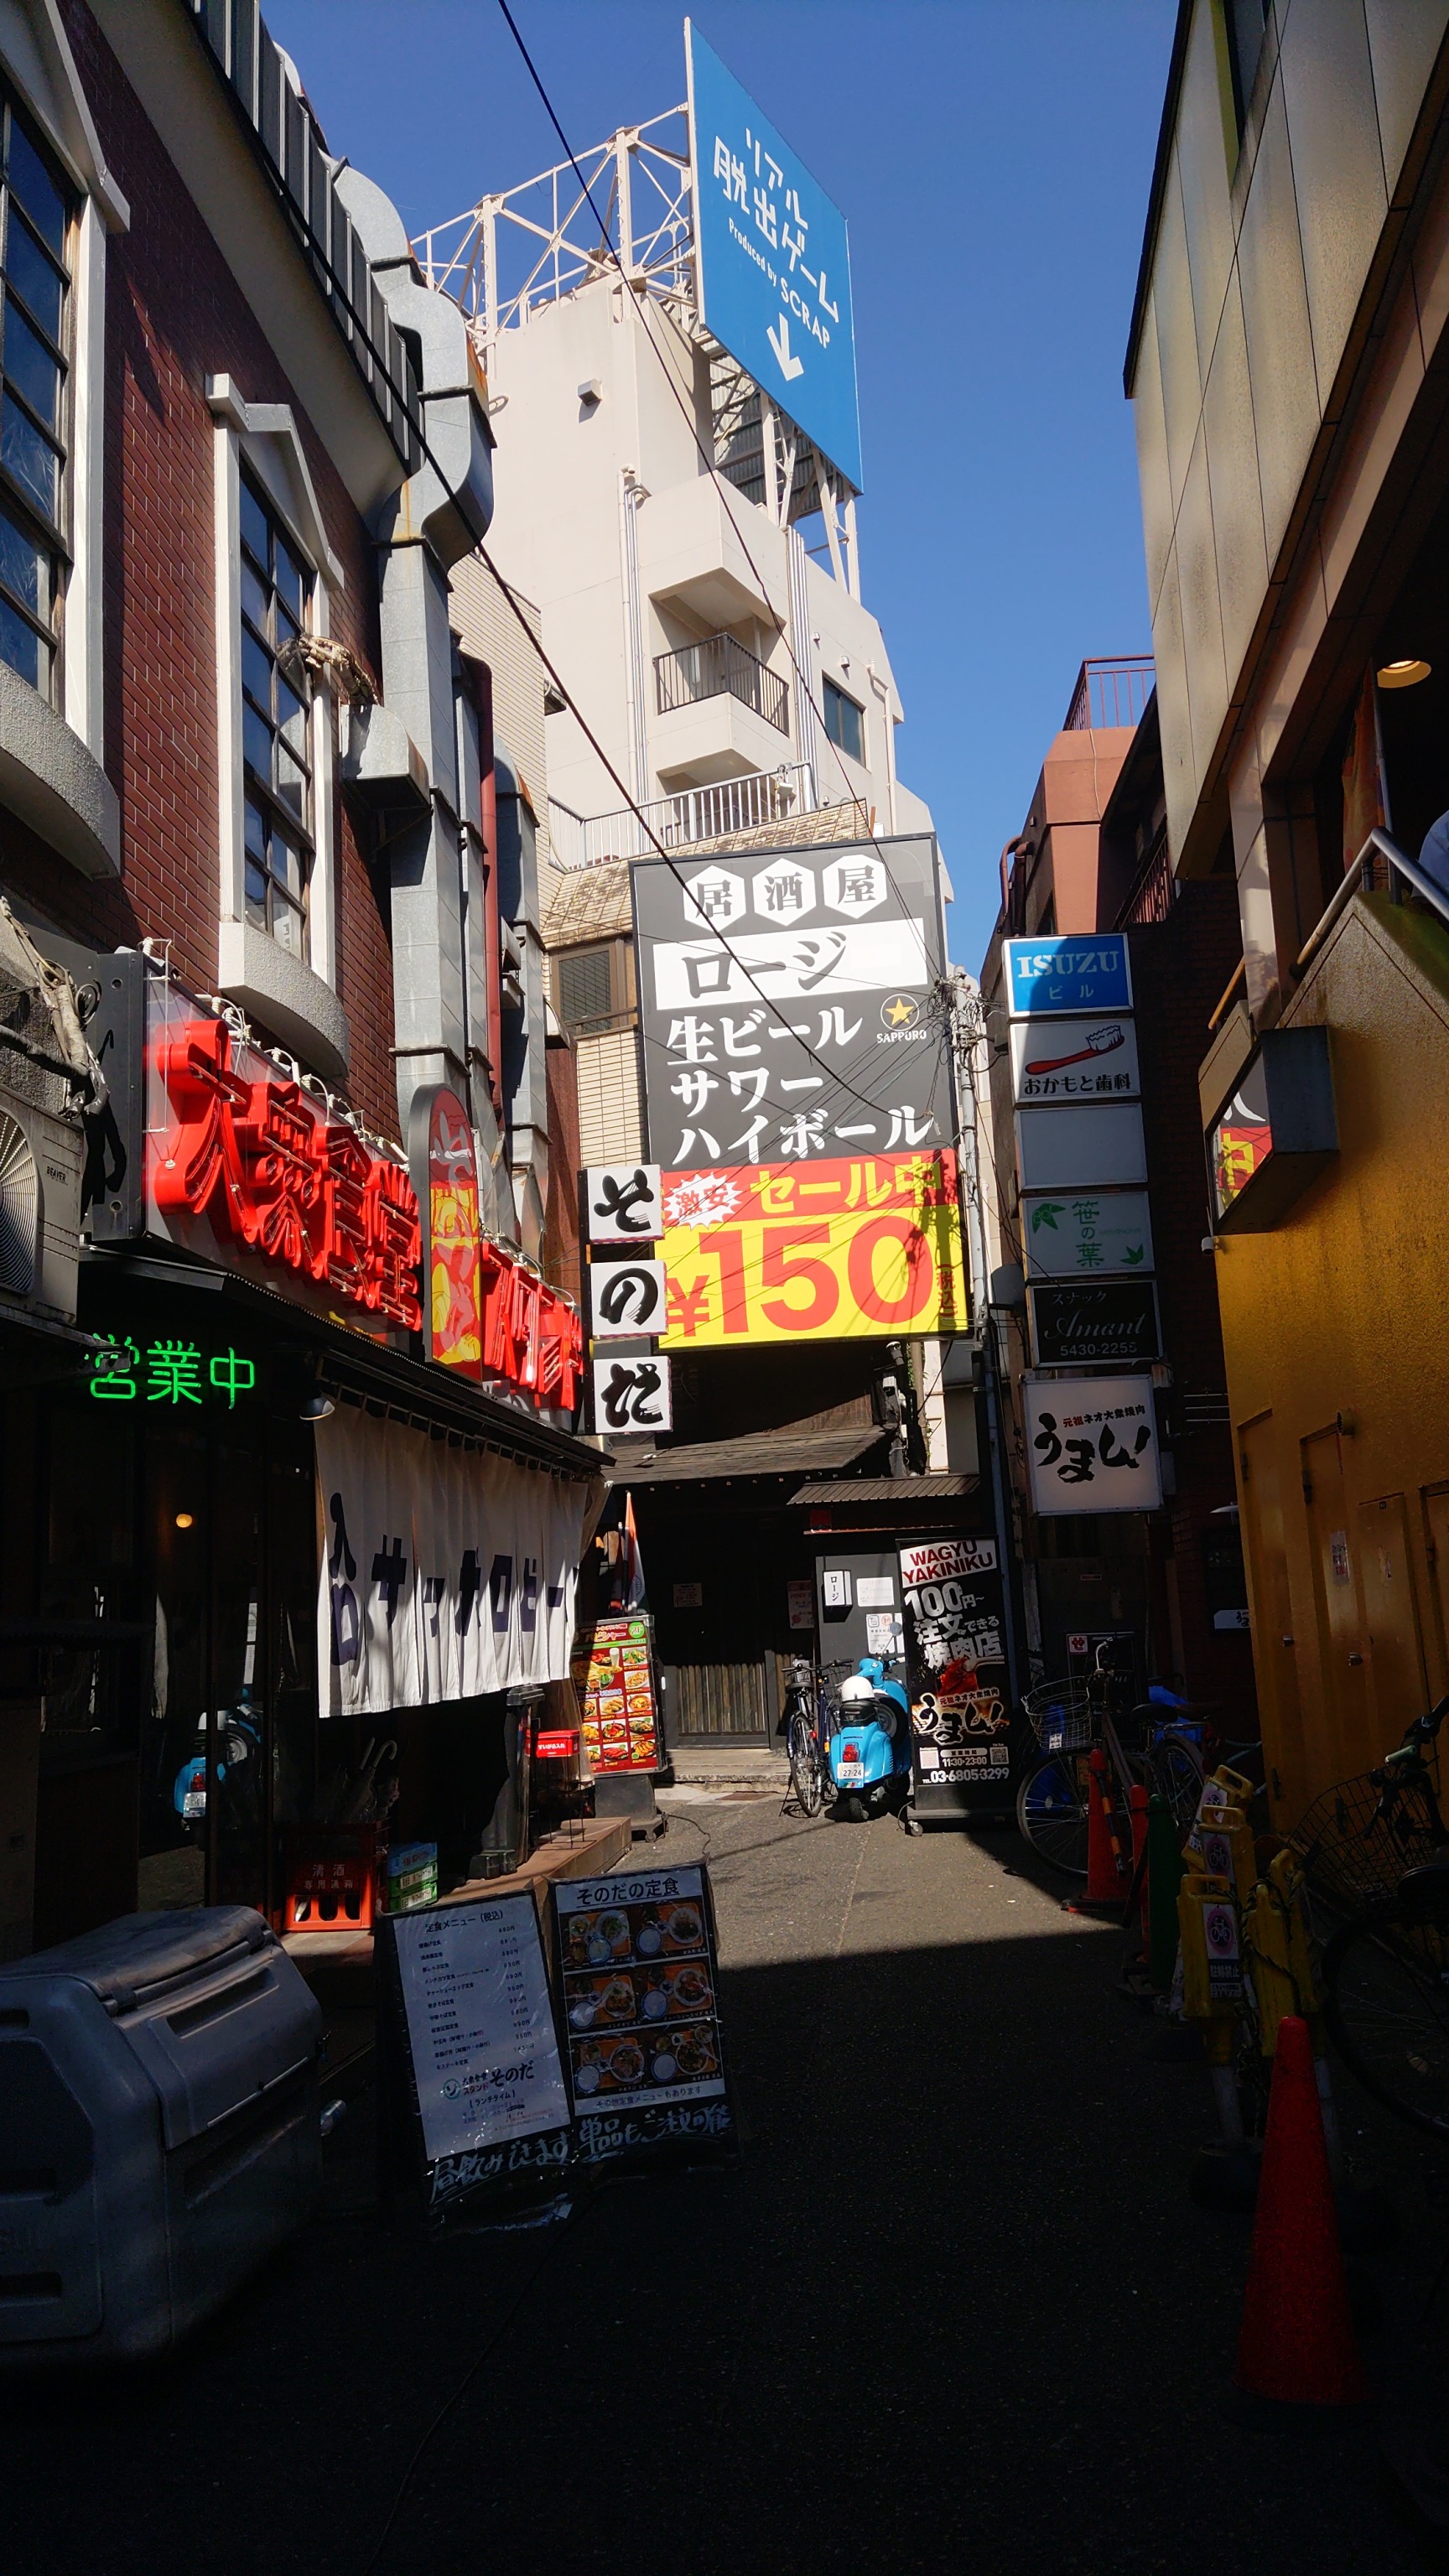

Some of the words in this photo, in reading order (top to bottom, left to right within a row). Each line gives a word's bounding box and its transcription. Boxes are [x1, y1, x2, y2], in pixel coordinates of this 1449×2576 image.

[745, 127, 809, 232] リアル
[712, 135, 839, 324] 脱出ゲーム
[728, 216, 766, 268] Produced
[766, 262, 778, 287] by
[780, 277, 831, 350] SCRAP
[695, 865, 888, 919] 居酒屋
[681, 931, 848, 1000] ロージ
[1016, 950, 1119, 979] ISUZU
[1048, 984, 1094, 1000] ビル
[666, 1006, 865, 1068] 生ビール
[875, 1030, 927, 1045] SAPPORO
[670, 1072, 824, 1119] サワー
[1024, 1072, 1131, 1095] おかもと歯科
[672, 1104, 933, 1166] ハイボール
[45, 1166, 67, 1182] BEAVER
[154, 1020, 422, 1332] 大衆食堂
[675, 1187, 732, 1217] 激安
[749, 1160, 944, 1213] セール中
[1072, 1200, 1104, 1268] 笹の葉
[1052, 1290, 1107, 1306] スナック
[1043, 1309, 1148, 1340] Amant
[1060, 1342, 1138, 1357] 5430-2255
[85, 1332, 256, 1410] 営業中
[1062, 1404, 1146, 1428] 元祖ネオ大衆焼肉
[909, 1540, 979, 1566] WAGYU
[902, 1551, 995, 1584] YAKINIKU
[830, 1576, 839, 1602] ロージ
[631, 1624, 643, 1634] 2F
[913, 1612, 1000, 1646] 注文できる
[925, 1631, 1003, 1670] 焼肉店
[939, 1687, 1000, 1706] 元祖ネオ大衆焼肉
[843, 1768, 862, 1777] 27-24
[930, 1767, 1010, 1784] 03-6805-3299
[312, 1863, 346, 1877] 清酒
[577, 1877, 681, 1905] そのだの定食
[424, 1974, 456, 1985] メンチカツ定食
[429, 2010, 457, 2021] 中華そば定食
[489, 2059, 535, 2088] そのだ
[463, 2081, 490, 2096] スタンド
[596, 2085, 703, 2109] その他定食メニューもあります
